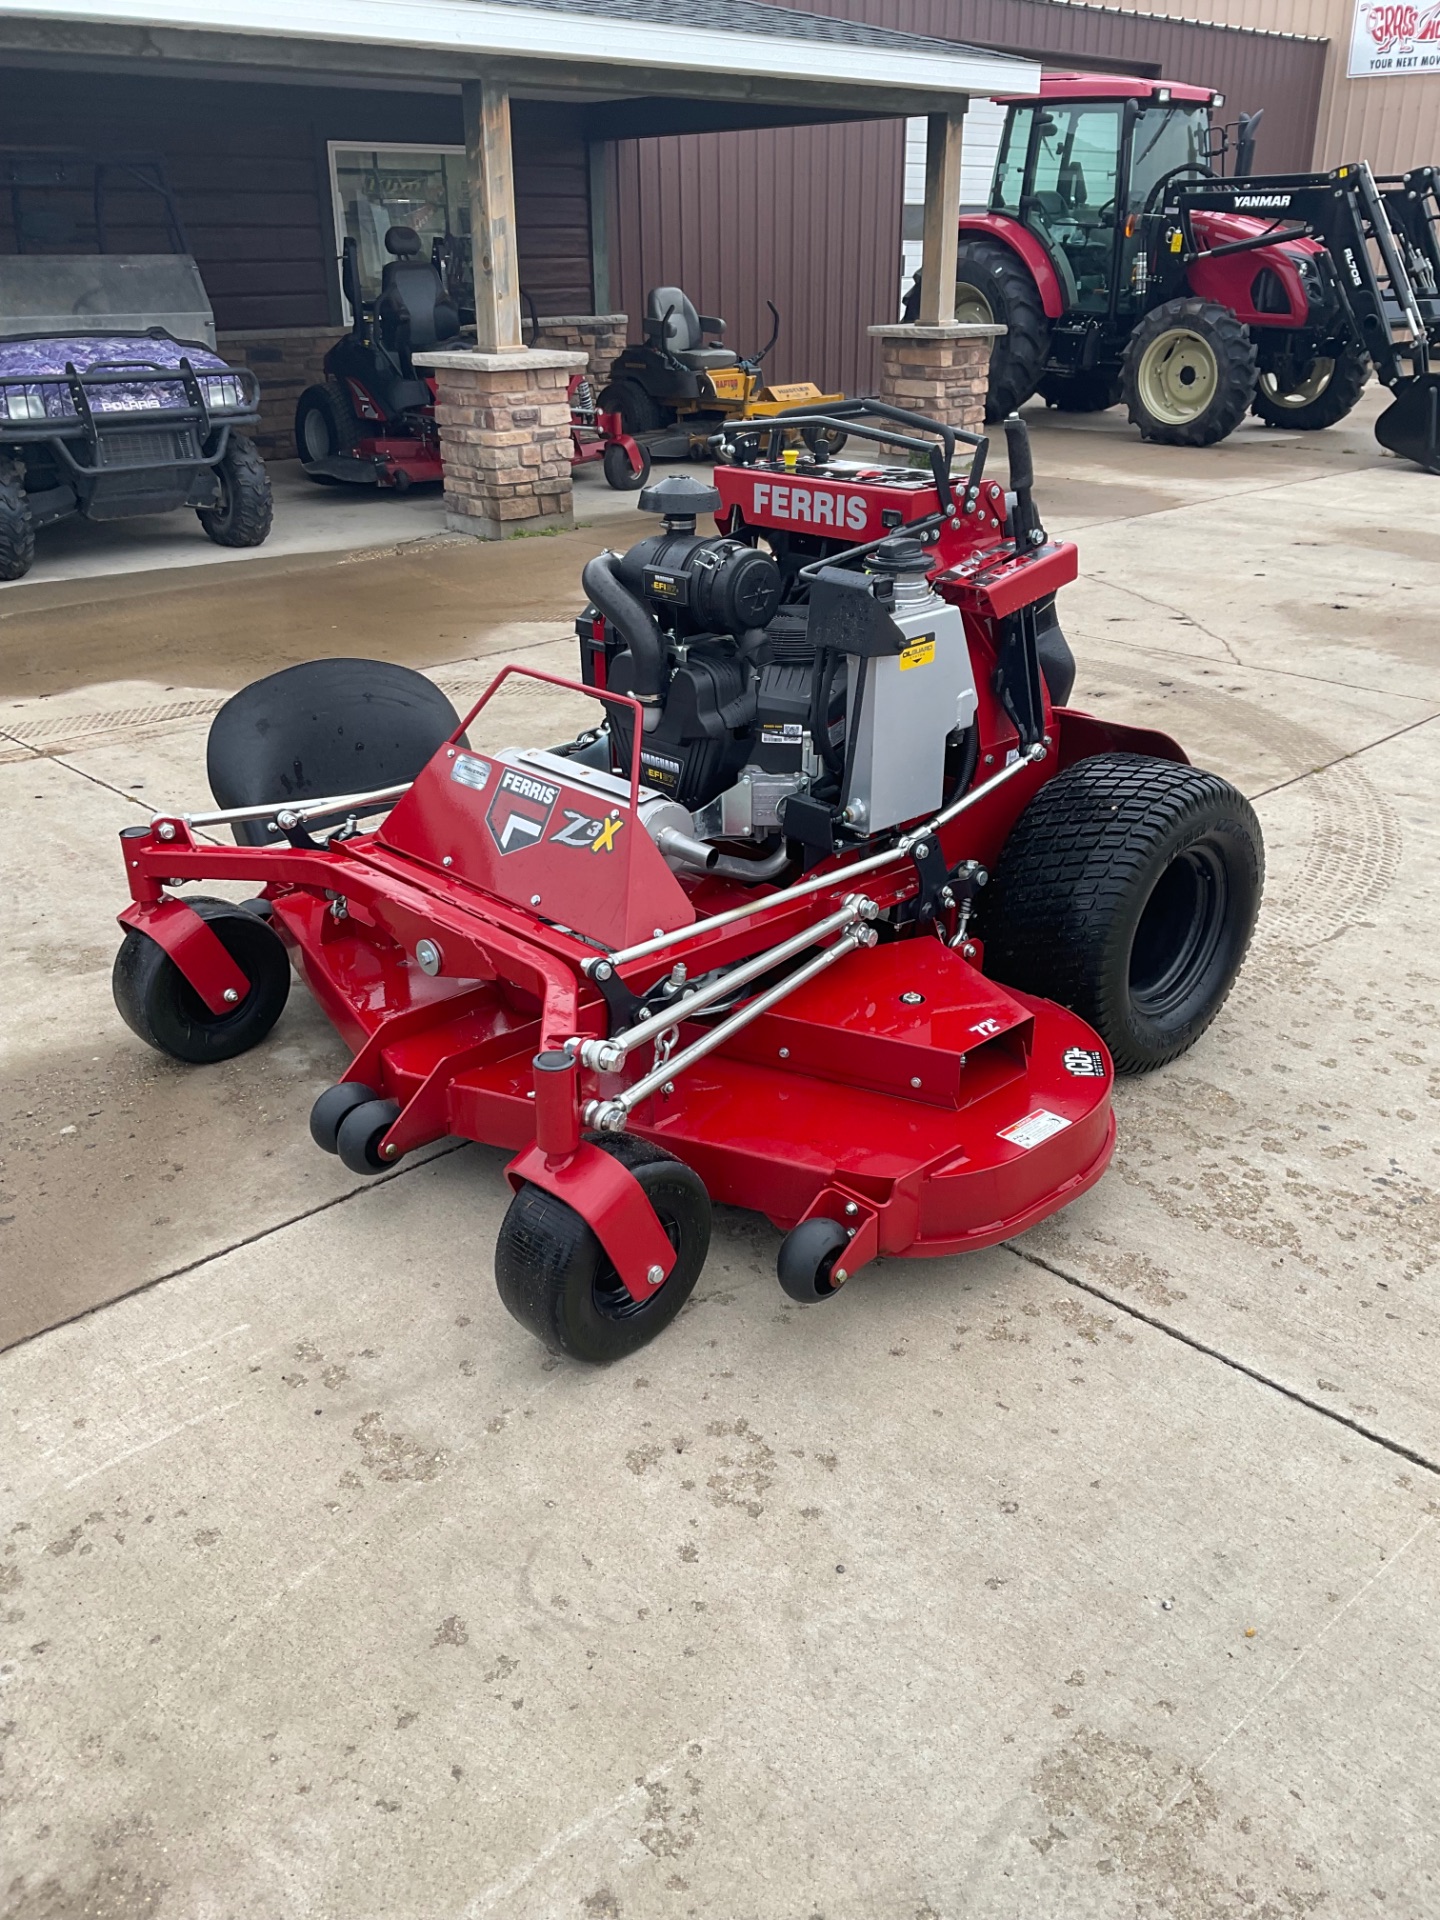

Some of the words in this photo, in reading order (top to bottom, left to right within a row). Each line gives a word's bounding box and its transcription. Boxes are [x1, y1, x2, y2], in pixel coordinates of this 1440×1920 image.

[1370, 58, 1393, 70] YOUR
[1396, 56, 1419, 68] NEXT
[1233, 194, 1292, 209] YANMAR
[101, 399, 161, 412] POLARIS
[753, 482, 868, 531] FERRIS
[653, 580, 668, 591] EFI
[648, 768, 663, 780] EFI
[502, 774, 555, 805] FERRIS
[968, 1018, 1001, 1036] 72"
